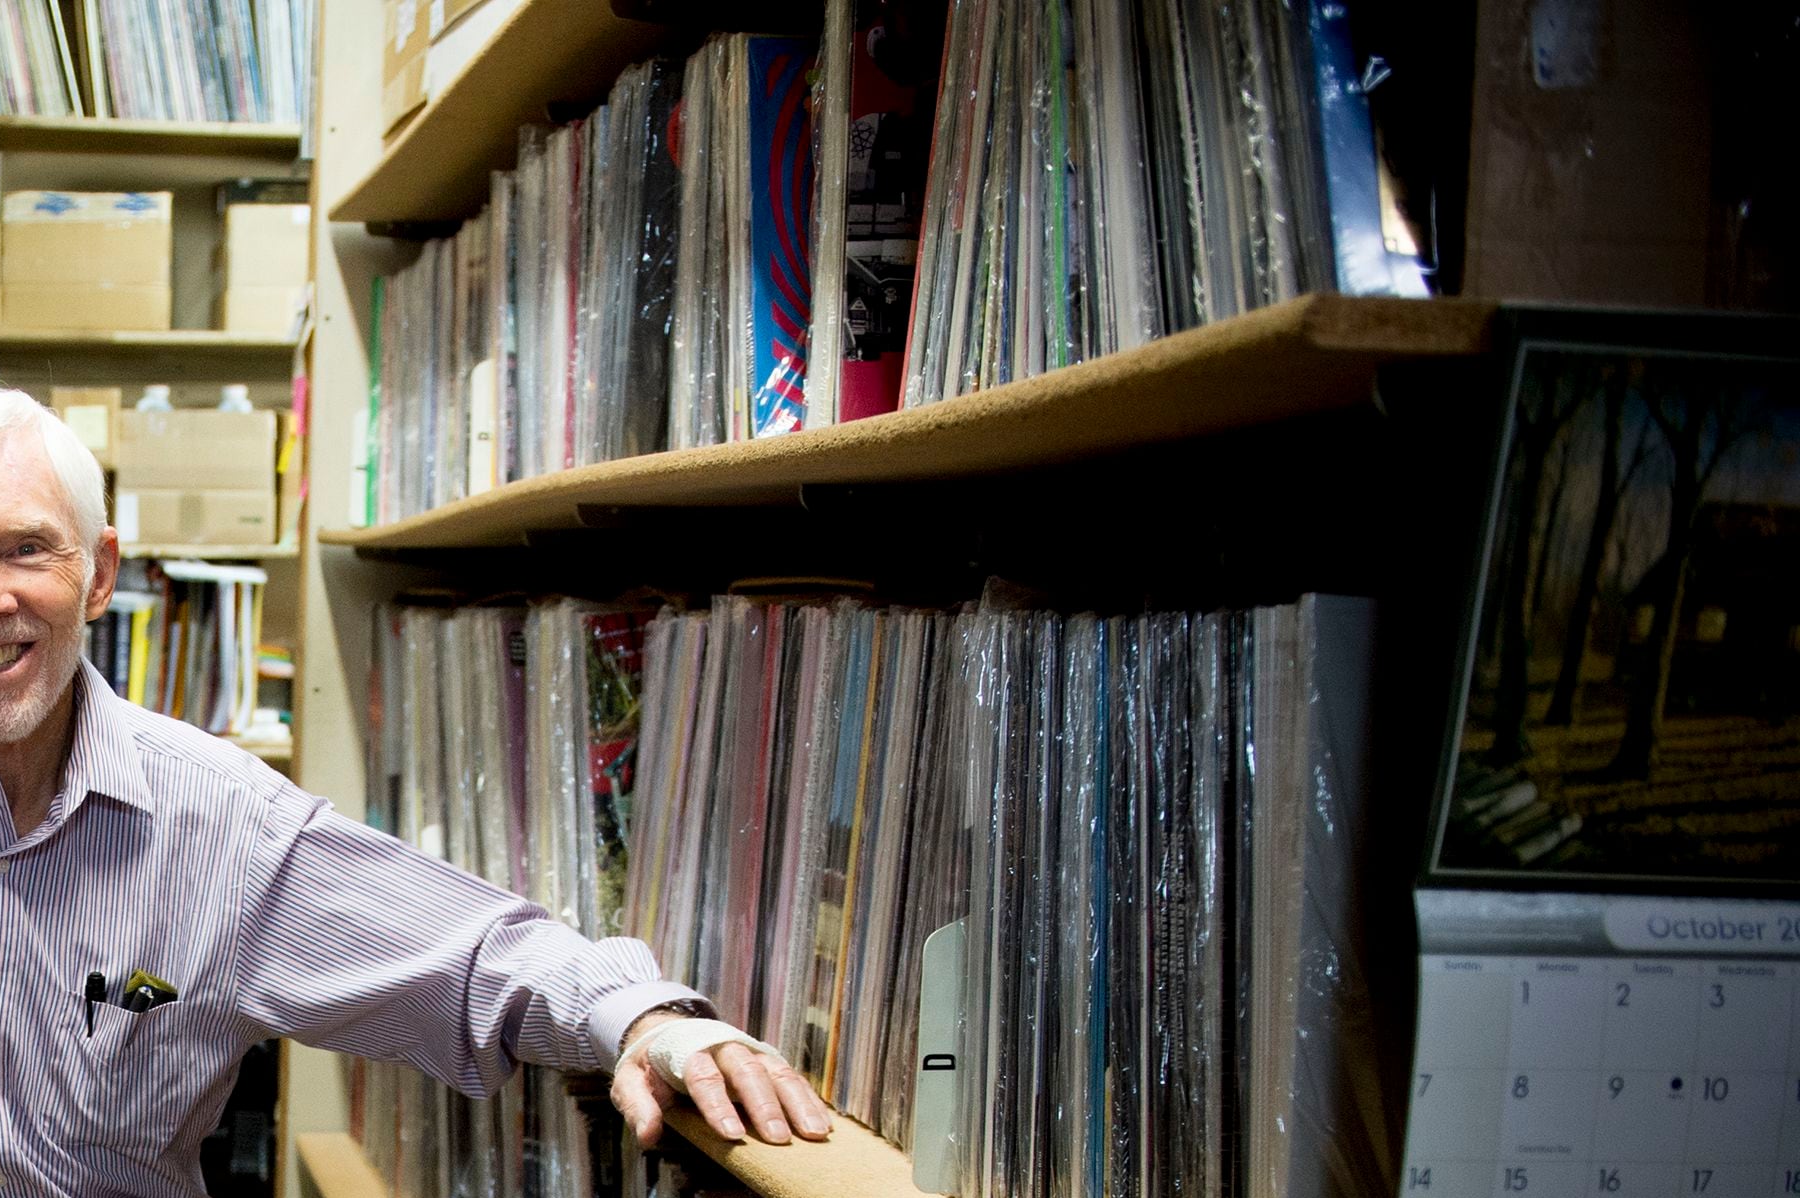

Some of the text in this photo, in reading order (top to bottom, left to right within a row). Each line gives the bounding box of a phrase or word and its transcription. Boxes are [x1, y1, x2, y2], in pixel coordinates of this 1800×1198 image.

[1646, 915, 1767, 941] October
[1444, 961, 1776, 977] Sunday Monday Tuesday Wednesday
[1521, 980, 1725, 1008] 1 2 3
[923, 1054, 956, 1070] D
[1418, 1074, 1729, 1101] 7 8 9 10
[1409, 1168, 1432, 1190] 14
[1503, 1168, 1529, 1191] 15
[1598, 1169, 1622, 1192] 16
[1692, 1169, 1714, 1192] 17
